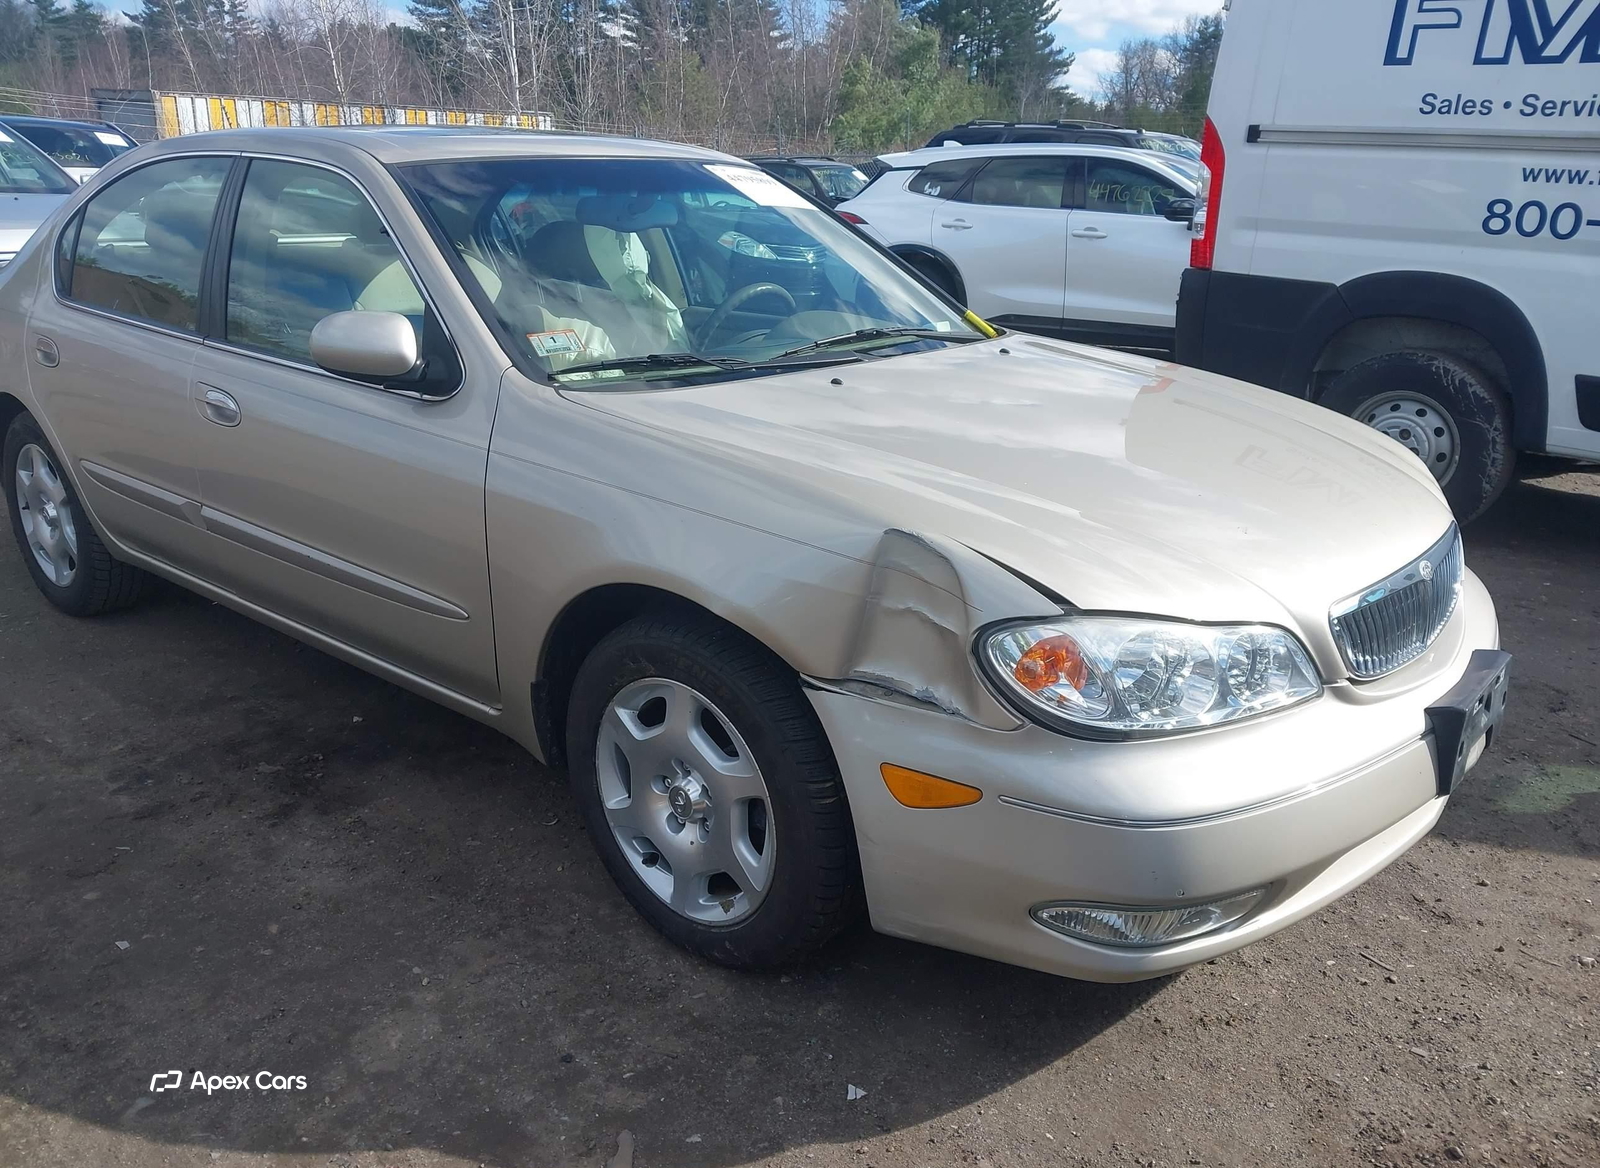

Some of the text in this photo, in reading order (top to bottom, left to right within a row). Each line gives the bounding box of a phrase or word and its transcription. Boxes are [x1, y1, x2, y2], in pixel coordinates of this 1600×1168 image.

[1418, 92, 1600, 117] Sales Servi
[1522, 167, 1600, 186] www.
[1481, 198, 1600, 240] 800-
